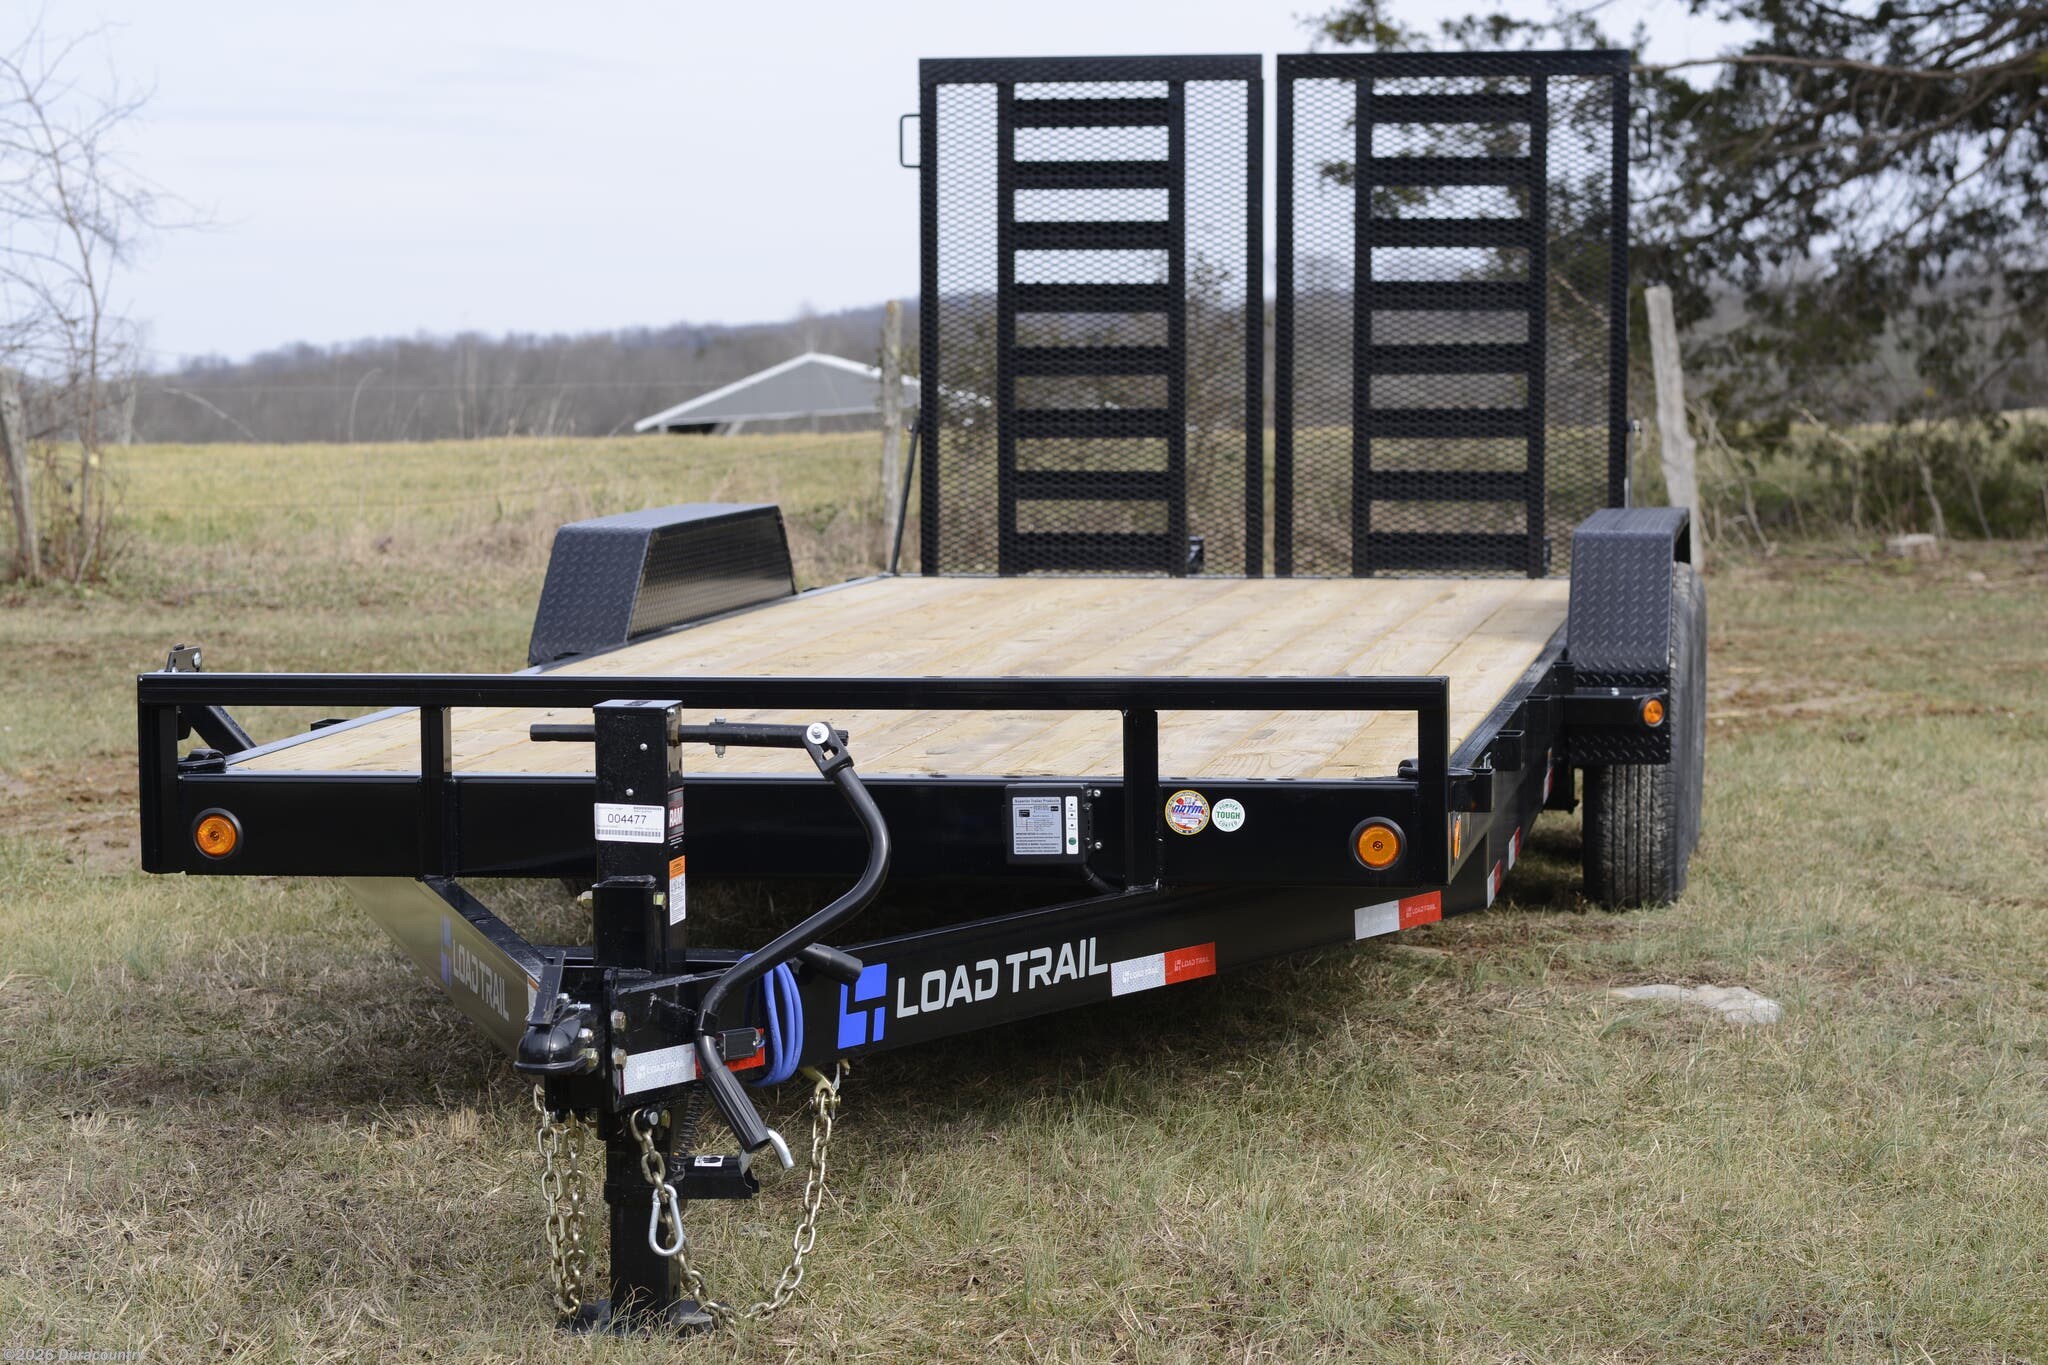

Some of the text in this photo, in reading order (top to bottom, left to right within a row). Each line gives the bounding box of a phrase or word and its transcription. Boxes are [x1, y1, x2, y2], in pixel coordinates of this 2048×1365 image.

[607, 813, 647, 825] 004477
[1216, 811, 1240, 820] TOUGH
[453, 939, 510, 1022] LOAD TRAIL
[896, 937, 1108, 1019] LOAD TRAIL
